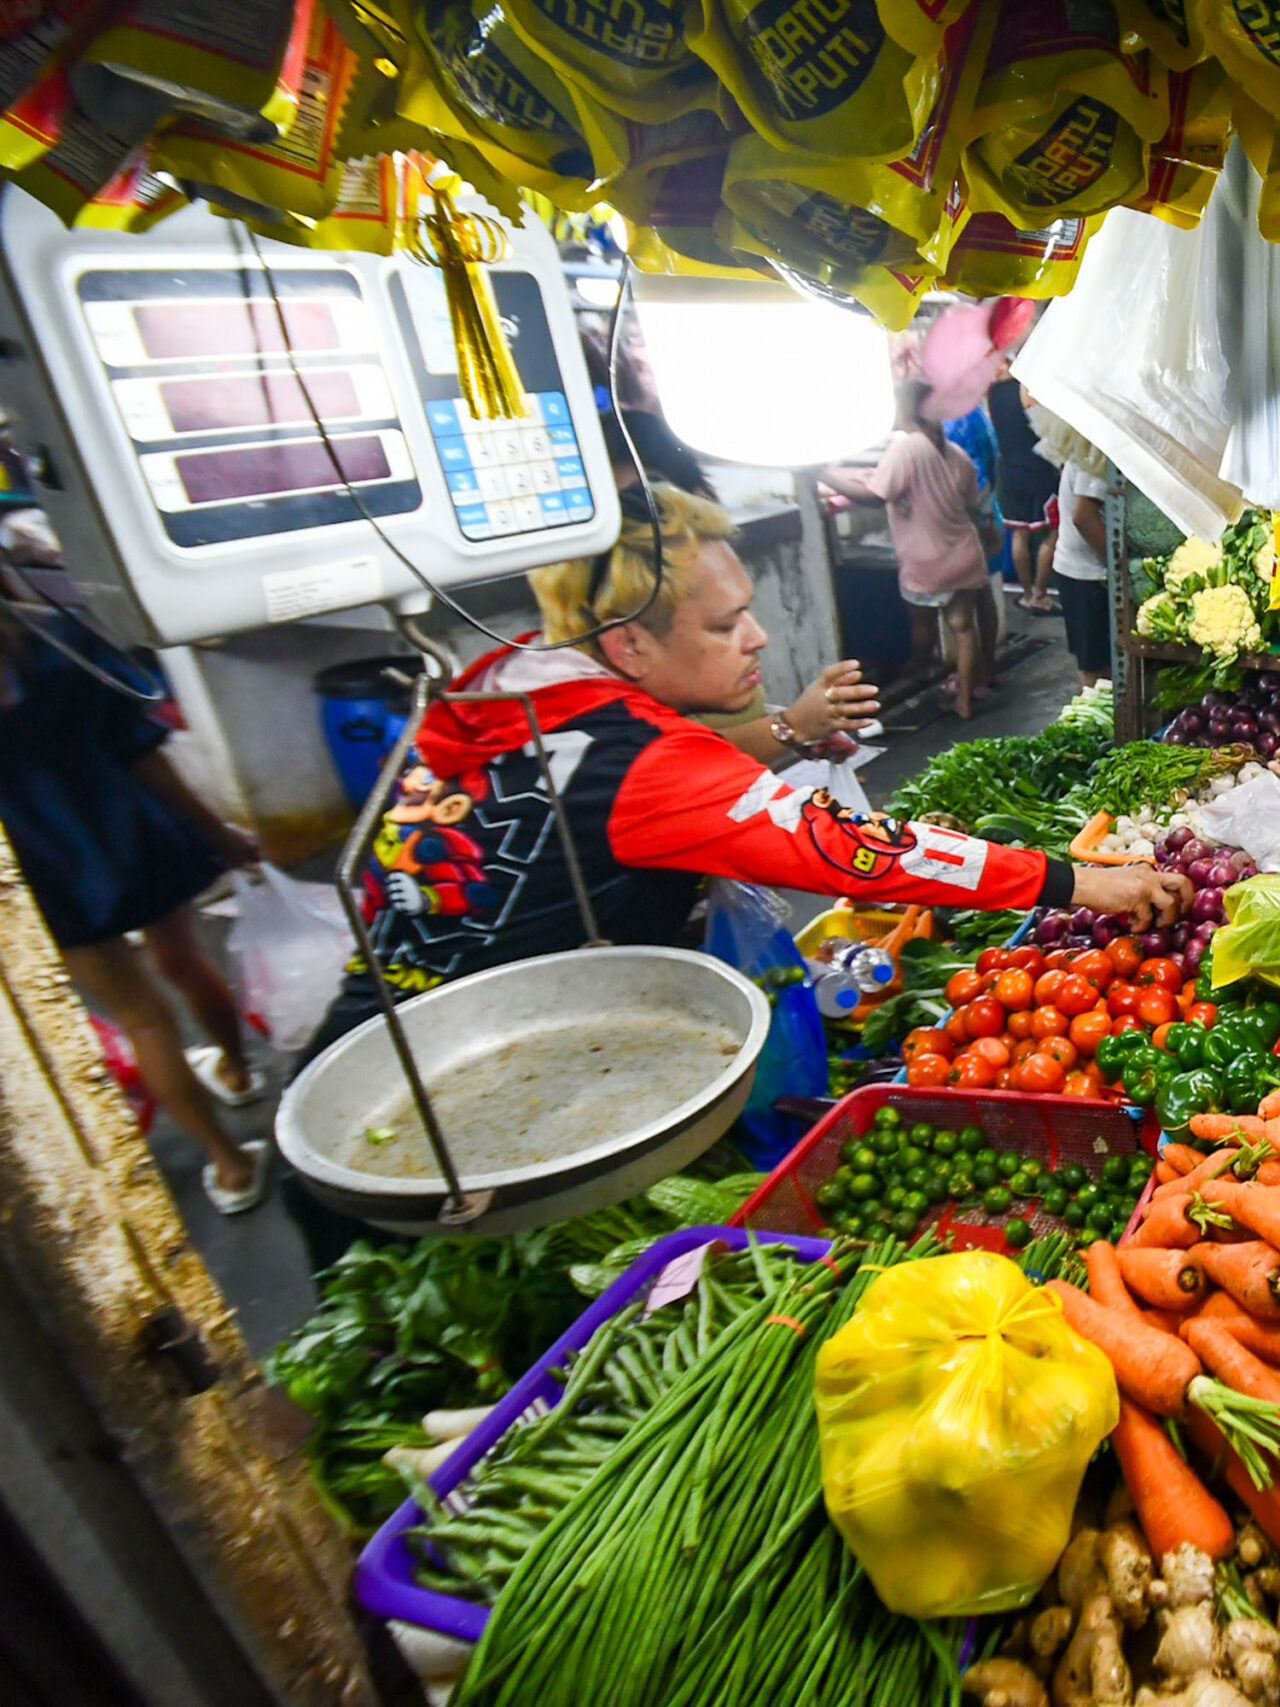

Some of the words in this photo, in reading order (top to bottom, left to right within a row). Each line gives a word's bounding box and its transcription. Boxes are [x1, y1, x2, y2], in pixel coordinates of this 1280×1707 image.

[758, 0, 853, 68] DATU
[790, 27, 870, 104] PUTI
[1029, 105, 1100, 179] DATU
[1053, 132, 1114, 190] PUTI
